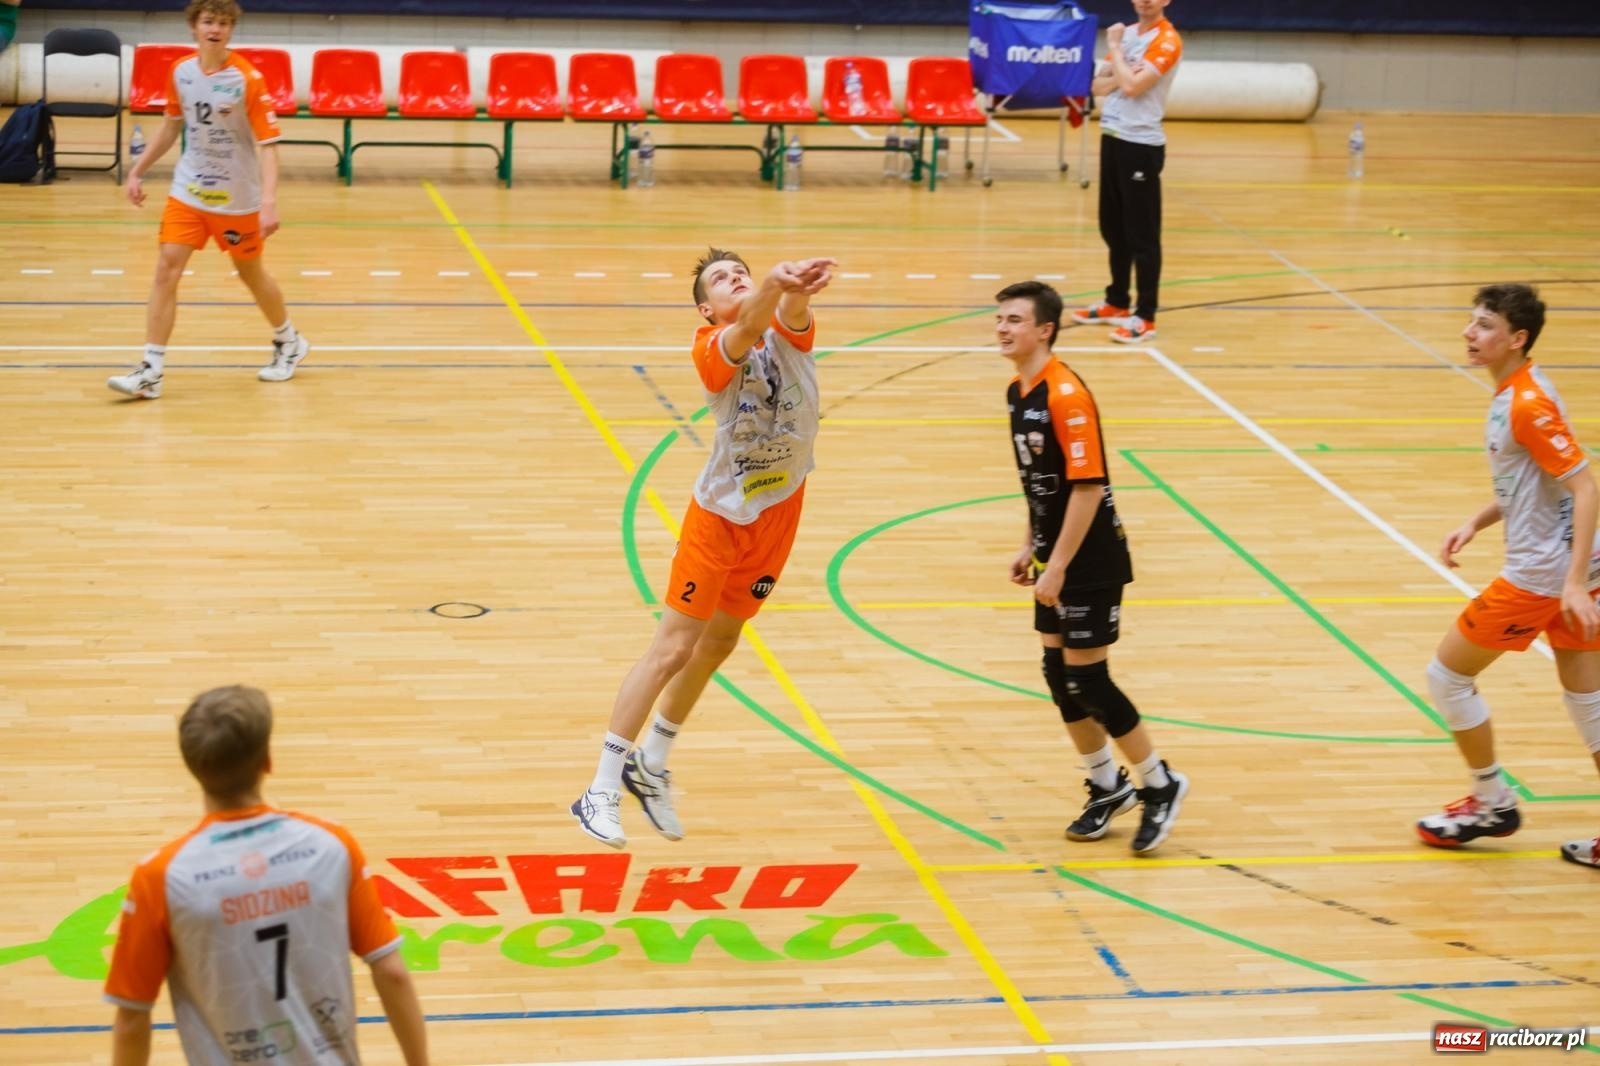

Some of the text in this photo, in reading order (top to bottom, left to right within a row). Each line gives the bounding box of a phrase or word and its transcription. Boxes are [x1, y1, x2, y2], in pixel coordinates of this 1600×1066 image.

[1007, 45, 1082, 64] molten
[195, 101, 213, 125] 12
[681, 582, 696, 602] 2
[752, 582, 774, 596] my
[194, 864, 236, 883] PRINZ
[366, 853, 859, 918] FAKO
[220, 881, 311, 926] SIDZINA
[255, 923, 288, 1001] 7
